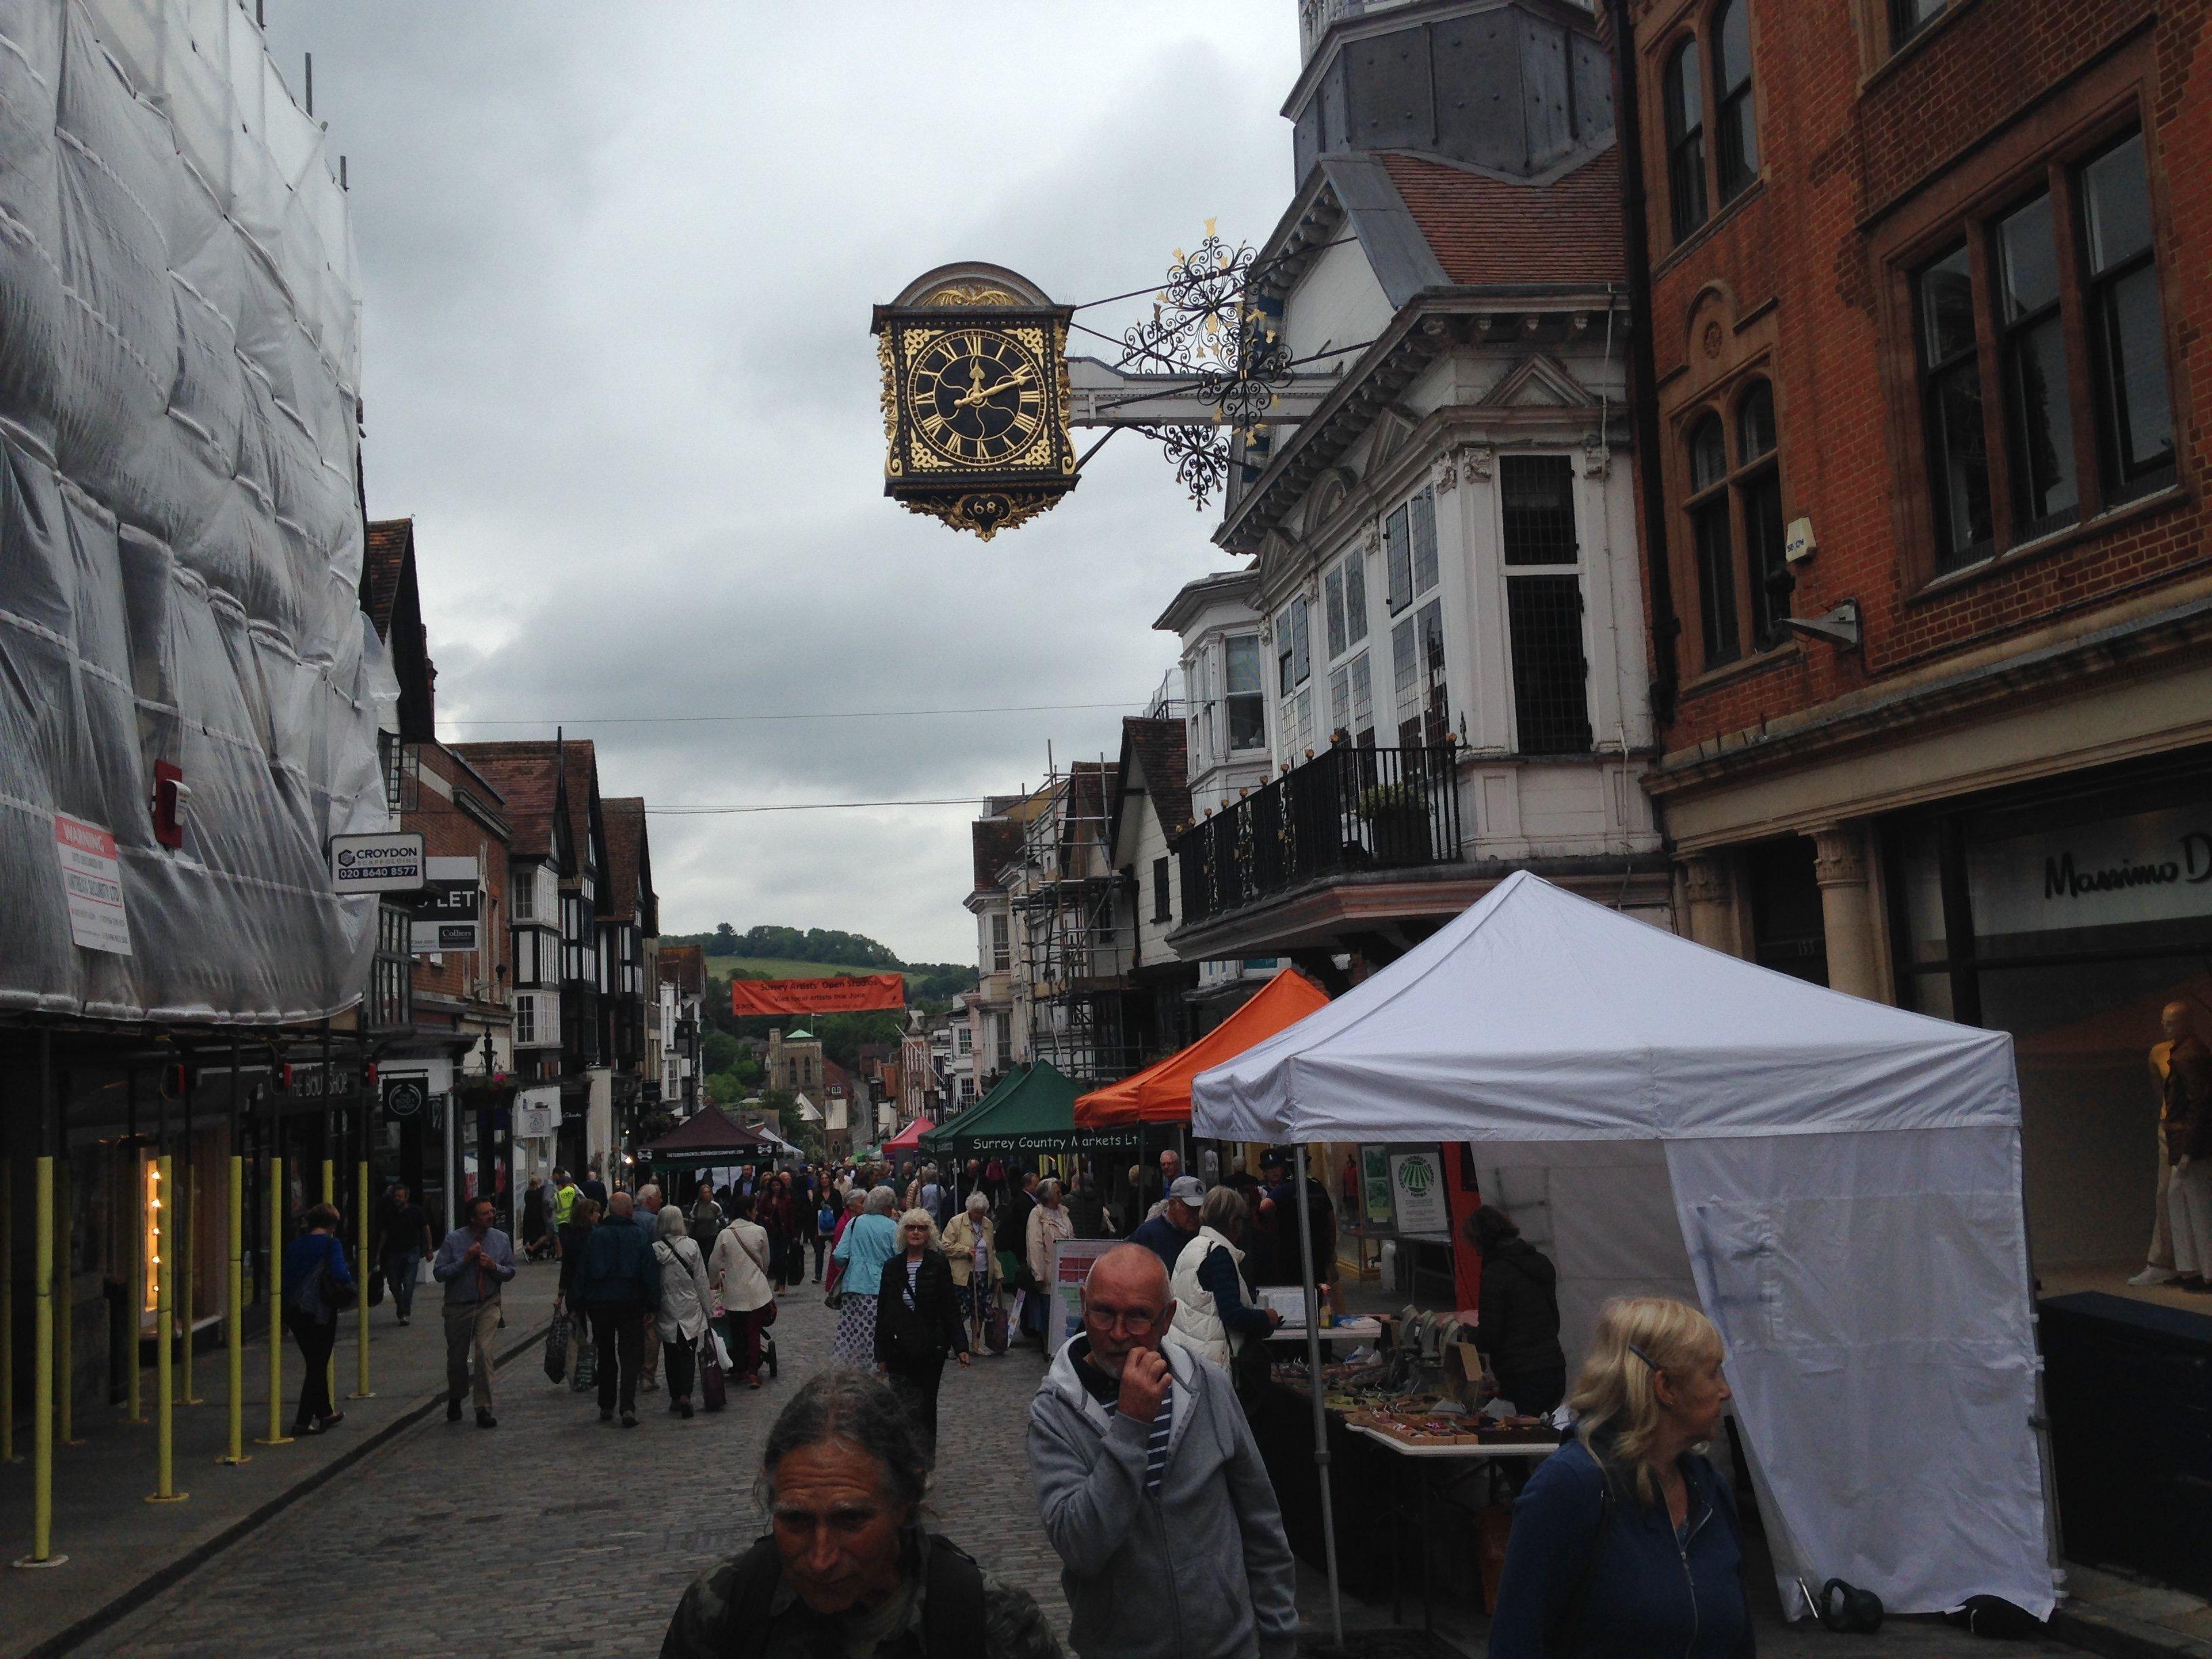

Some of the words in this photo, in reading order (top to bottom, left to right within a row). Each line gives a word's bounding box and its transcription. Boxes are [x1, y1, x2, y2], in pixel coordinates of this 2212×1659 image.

[967, 501, 1003, 518] 1683
[356, 847, 417, 859] CROYDON
[357, 857, 417, 866] SCAFFOLDING
[340, 869, 359, 879] 020
[363, 867, 388, 877] 8640
[391, 866, 415, 876] 8577
[2045, 851, 2179, 899] Massimo
[760, 983, 787, 992] Surrey
[846, 979, 878, 987] Studios
[973, 1138, 1015, 1151] Surrey
[1019, 1136, 1066, 1150] Country
